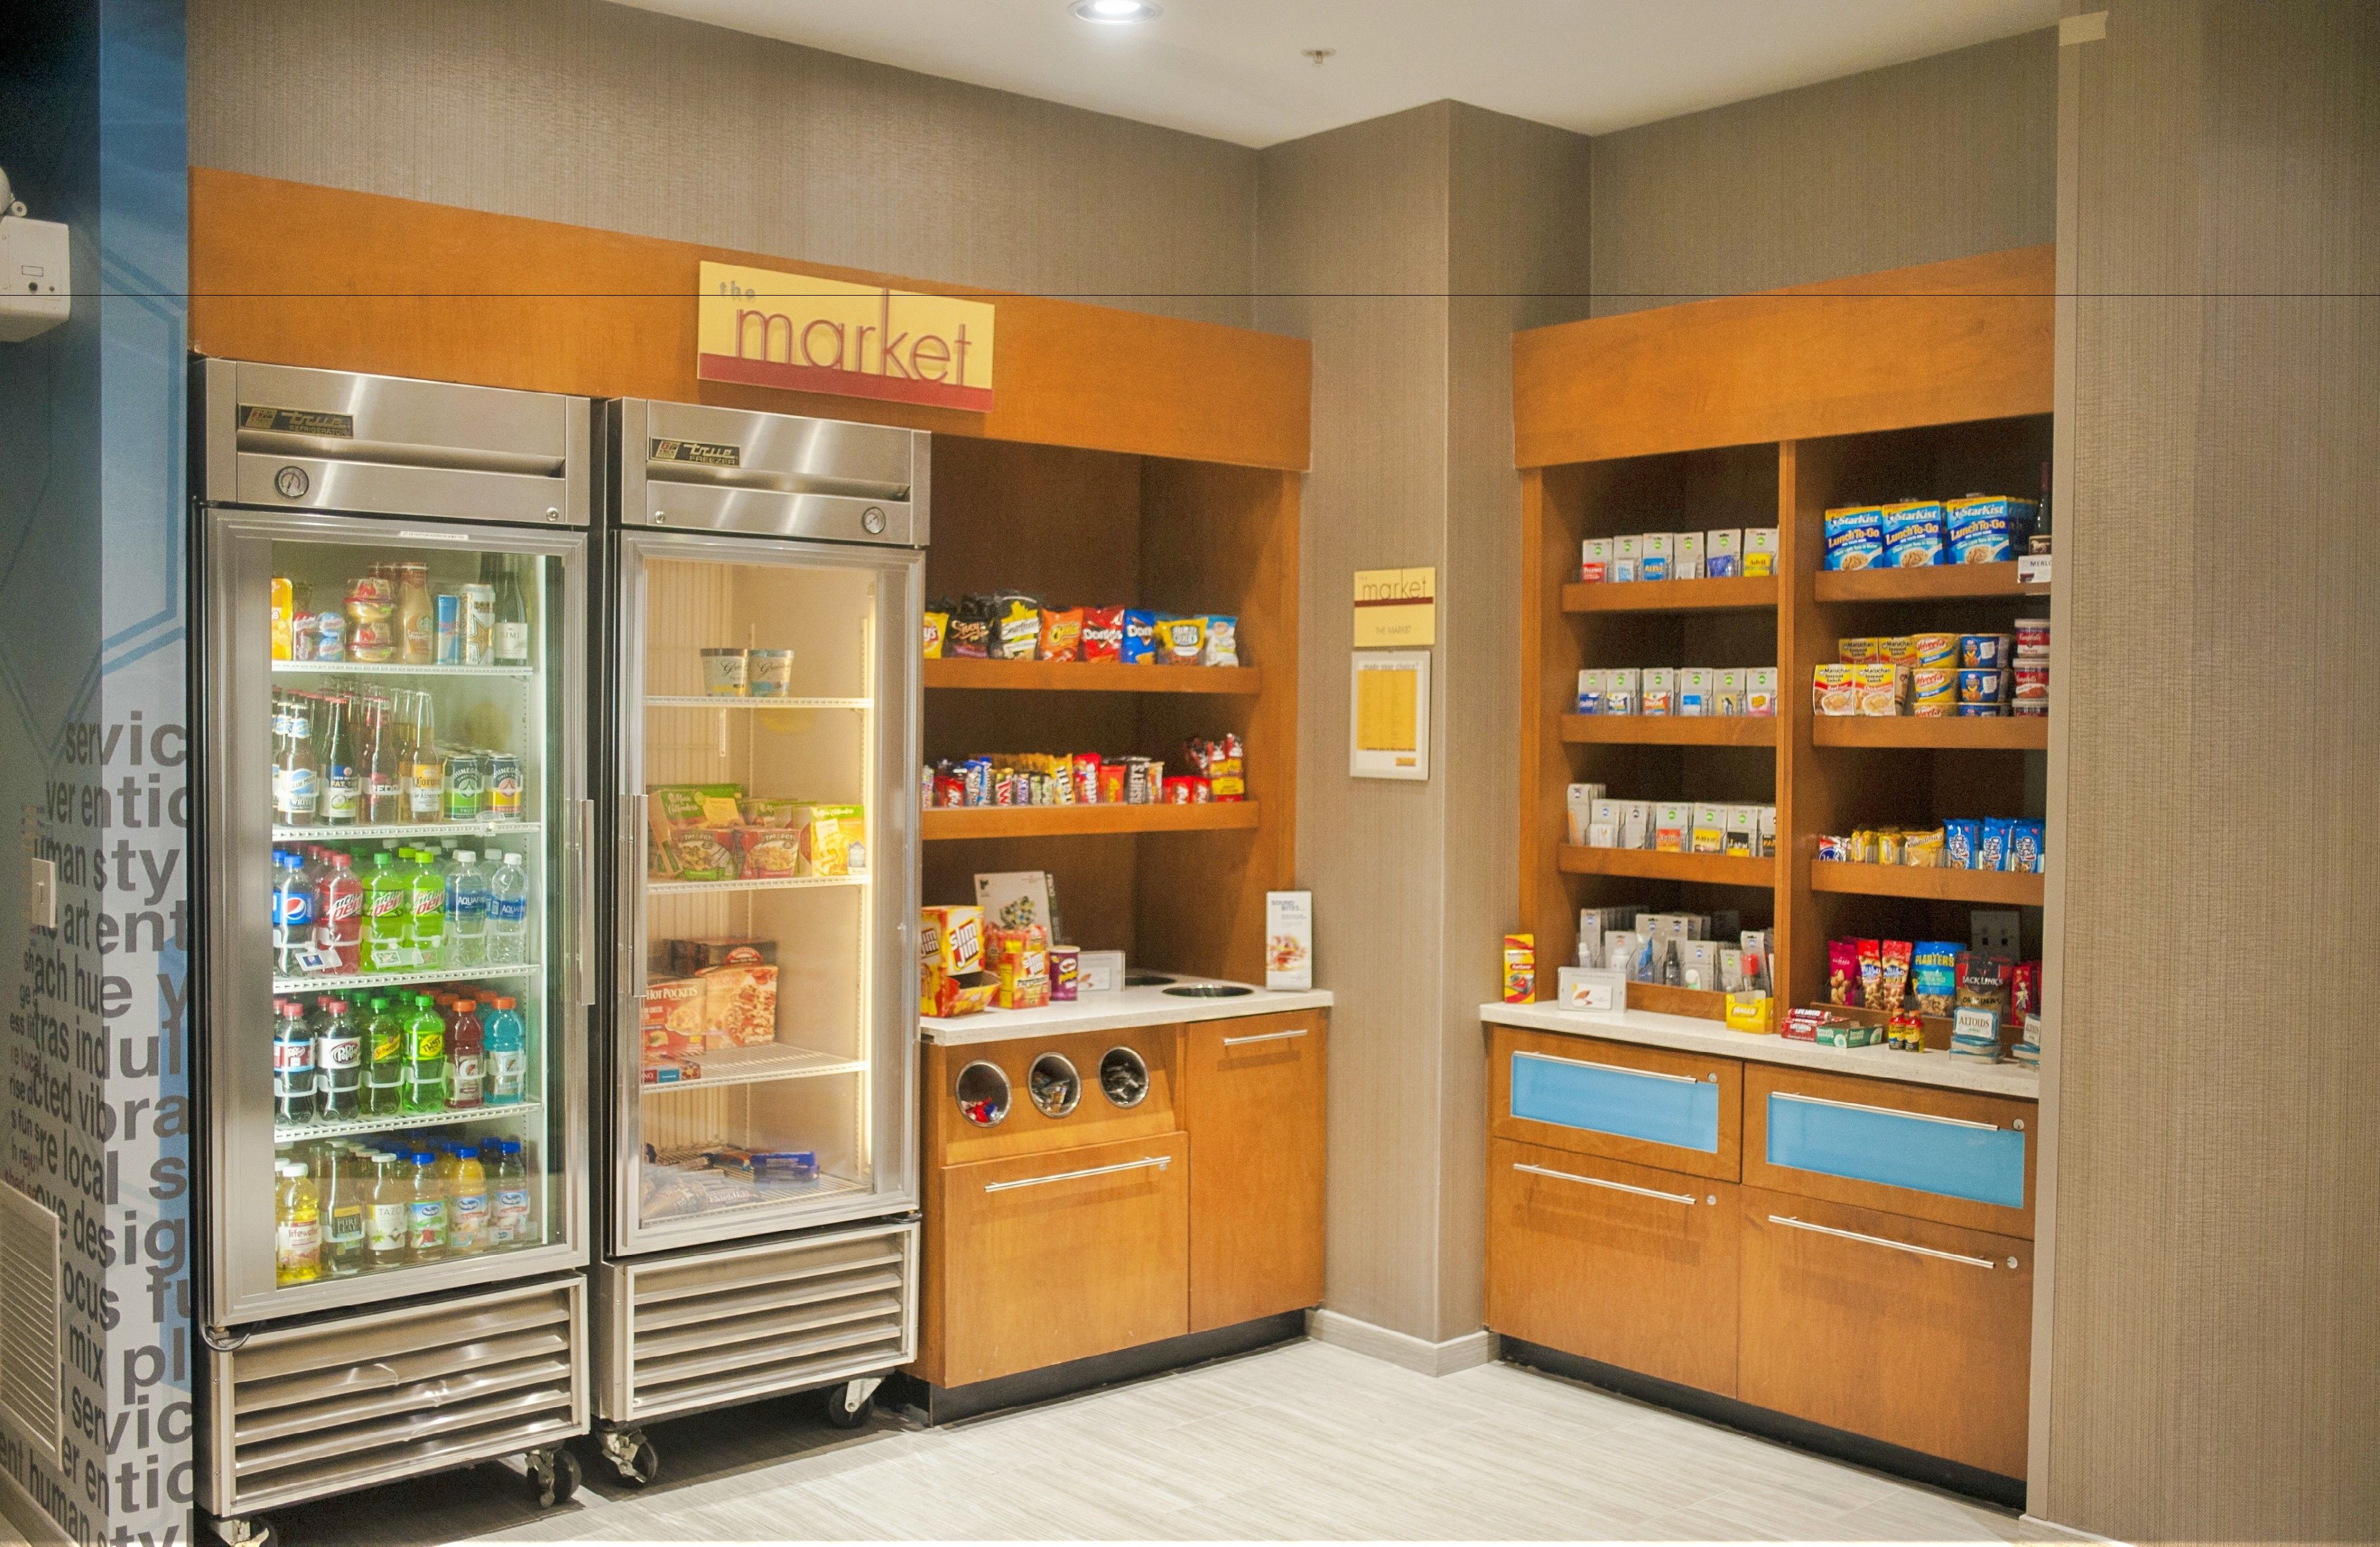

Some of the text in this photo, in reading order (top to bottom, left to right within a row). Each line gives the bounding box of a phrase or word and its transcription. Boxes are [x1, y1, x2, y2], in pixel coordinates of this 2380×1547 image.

[719, 280, 756, 302] the
[736, 288, 972, 386] market
[683, 443, 735, 459] true
[689, 456, 735, 465] FREEZER
[1897, 509, 1937, 521] StarKist
[1962, 505, 2004, 516] StarKist
[1838, 514, 1879, 526] StarKist
[1828, 530, 1855, 549] Lunch
[1886, 526, 1913, 545] Lunch
[1950, 521, 1978, 542] Lunch
[1364, 569, 1427, 600] market
[1083, 627, 1123, 641] Doritos
[93, 839, 180, 906] sty
[949, 922, 976, 951] slim
[957, 937, 979, 967] jim
[1915, 954, 1955, 967] PLANTERS
[74, 953, 133, 1019] hue
[1963, 976, 1980, 985] JACK
[663, 986, 698, 999] POCKETS
[1959, 1016, 1990, 1028] ALTOIDS
[421, 1036, 441, 1052] TWIST
[63, 1129, 118, 1205] local
[379, 1207, 402, 1215] TAZO
[337, 1217, 359, 1227] PURE
[288, 1228, 318, 1238] lifewater
[69, 1324, 104, 1390] mix
